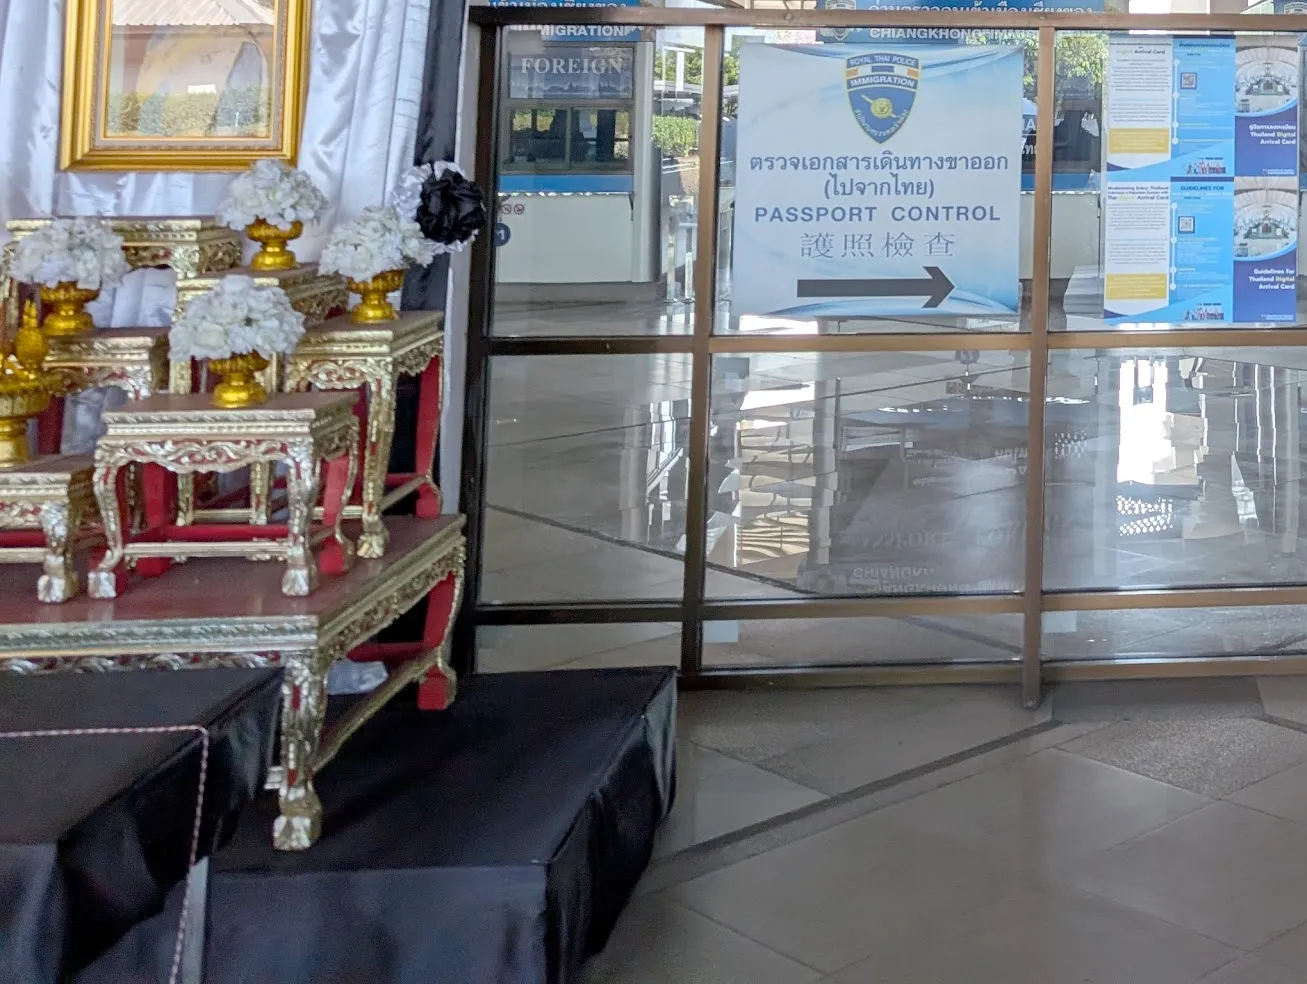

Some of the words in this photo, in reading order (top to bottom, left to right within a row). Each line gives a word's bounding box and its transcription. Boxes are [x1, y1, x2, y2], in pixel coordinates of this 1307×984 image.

[535, 24, 625, 37] MIGRATION
[521, 58, 622, 74] FOREIGN
[850, 57, 872, 66] ROYAL
[892, 56, 917, 67] POLICE
[850, 76, 915, 87] IMMIGRATION
[750, 150, 1008, 171] ตรวจเอกสารเดินทางขาออก
[824, 172, 935, 199] (ไปจากไทย)
[754, 206, 877, 223] PASSPORT
[891, 205, 1001, 222] CONTROL
[800, 231, 956, 259] 護照檢查
